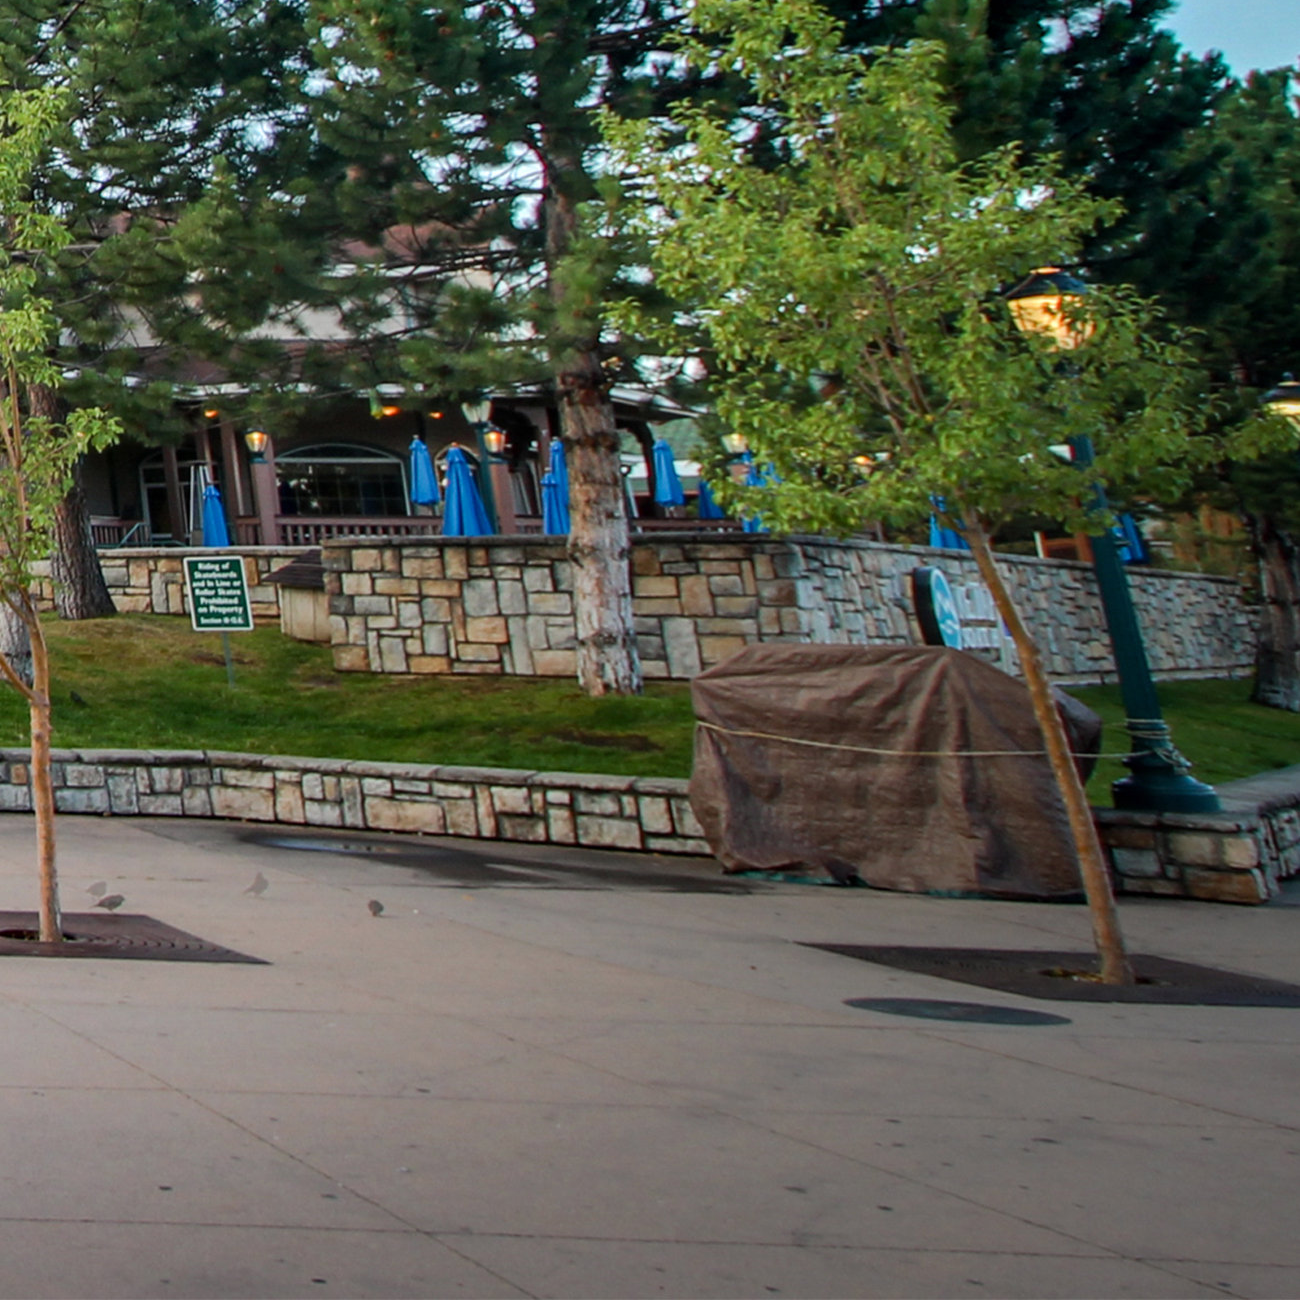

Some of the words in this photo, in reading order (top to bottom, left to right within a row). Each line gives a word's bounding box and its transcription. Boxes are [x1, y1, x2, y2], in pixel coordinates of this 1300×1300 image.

[198, 562, 220, 571] Riding
[221, 562, 230, 570] of
[194, 571, 238, 579] Skateboards
[194, 588, 216, 596] Roller
[200, 596, 239, 605] Prohibited
[209, 605, 243, 615] Property
